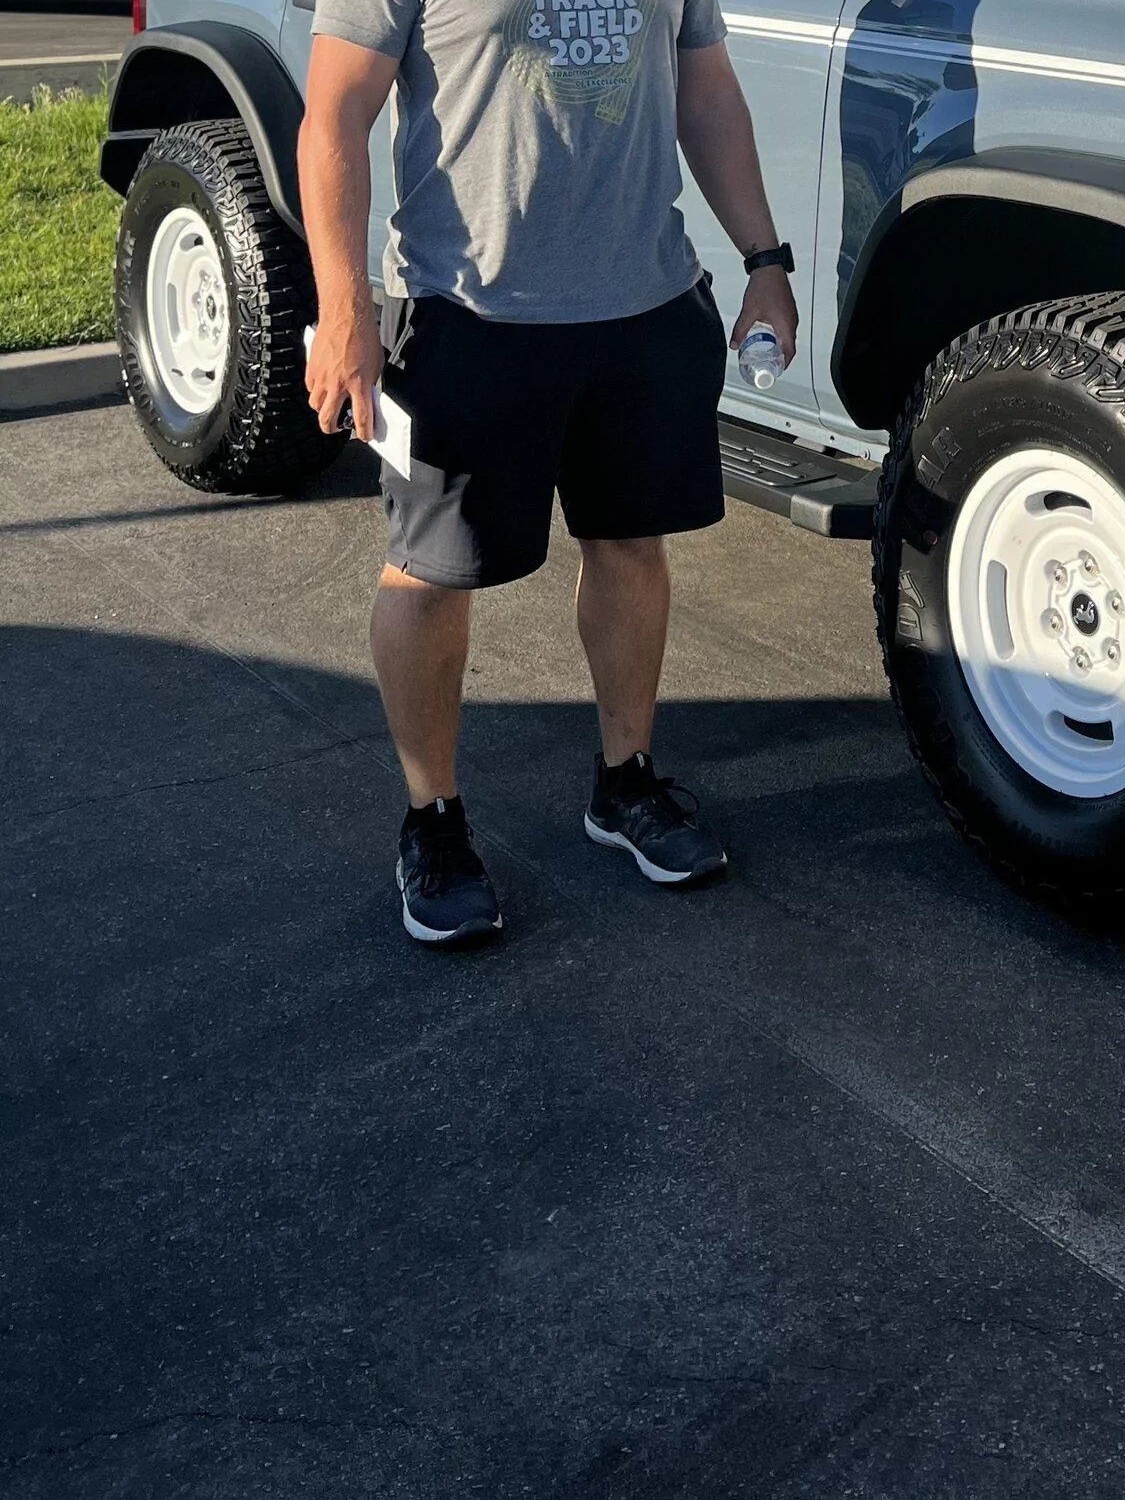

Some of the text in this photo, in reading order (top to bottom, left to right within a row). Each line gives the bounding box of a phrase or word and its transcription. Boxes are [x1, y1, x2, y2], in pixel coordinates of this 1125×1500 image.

[527, 8, 644, 39] & FIELD
[548, 35, 631, 67] 2023
